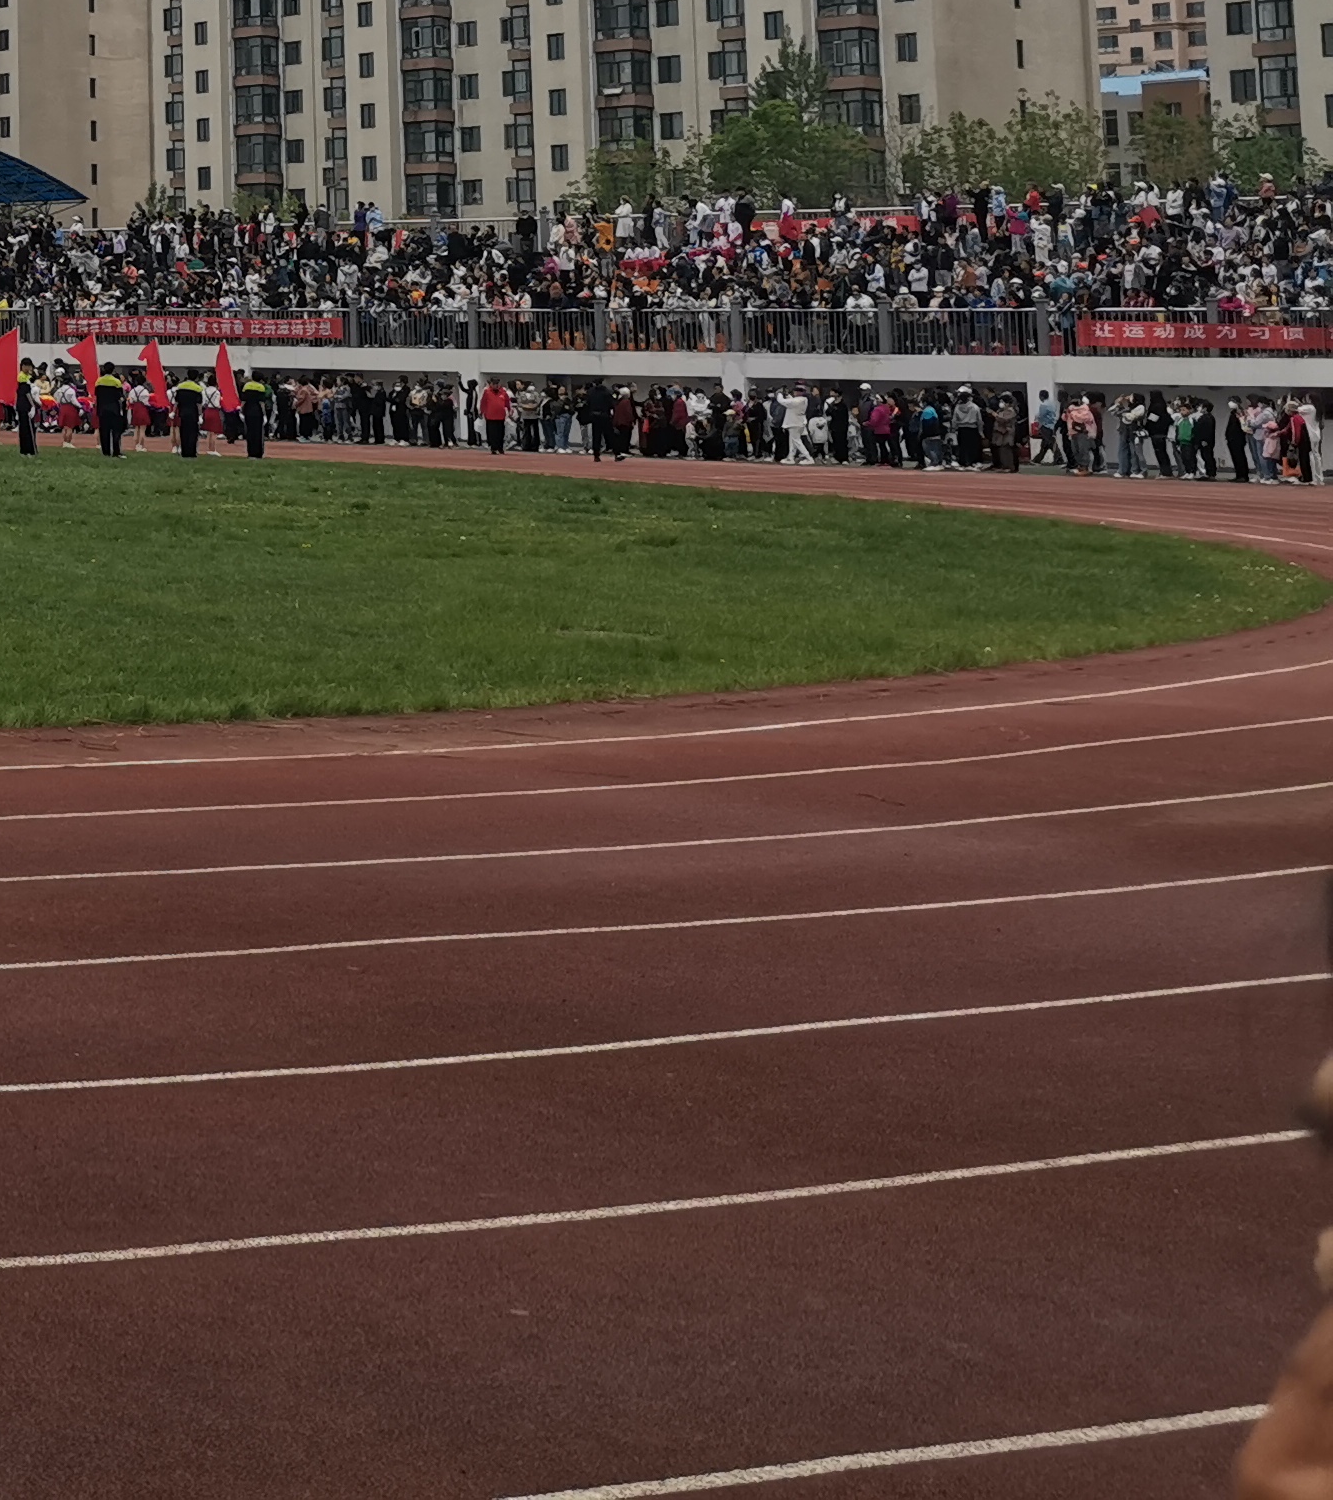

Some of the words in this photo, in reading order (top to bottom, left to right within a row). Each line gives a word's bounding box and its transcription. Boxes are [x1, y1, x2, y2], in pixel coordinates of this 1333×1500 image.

[1093, 323, 1305, 341] 让运动成为习惯
